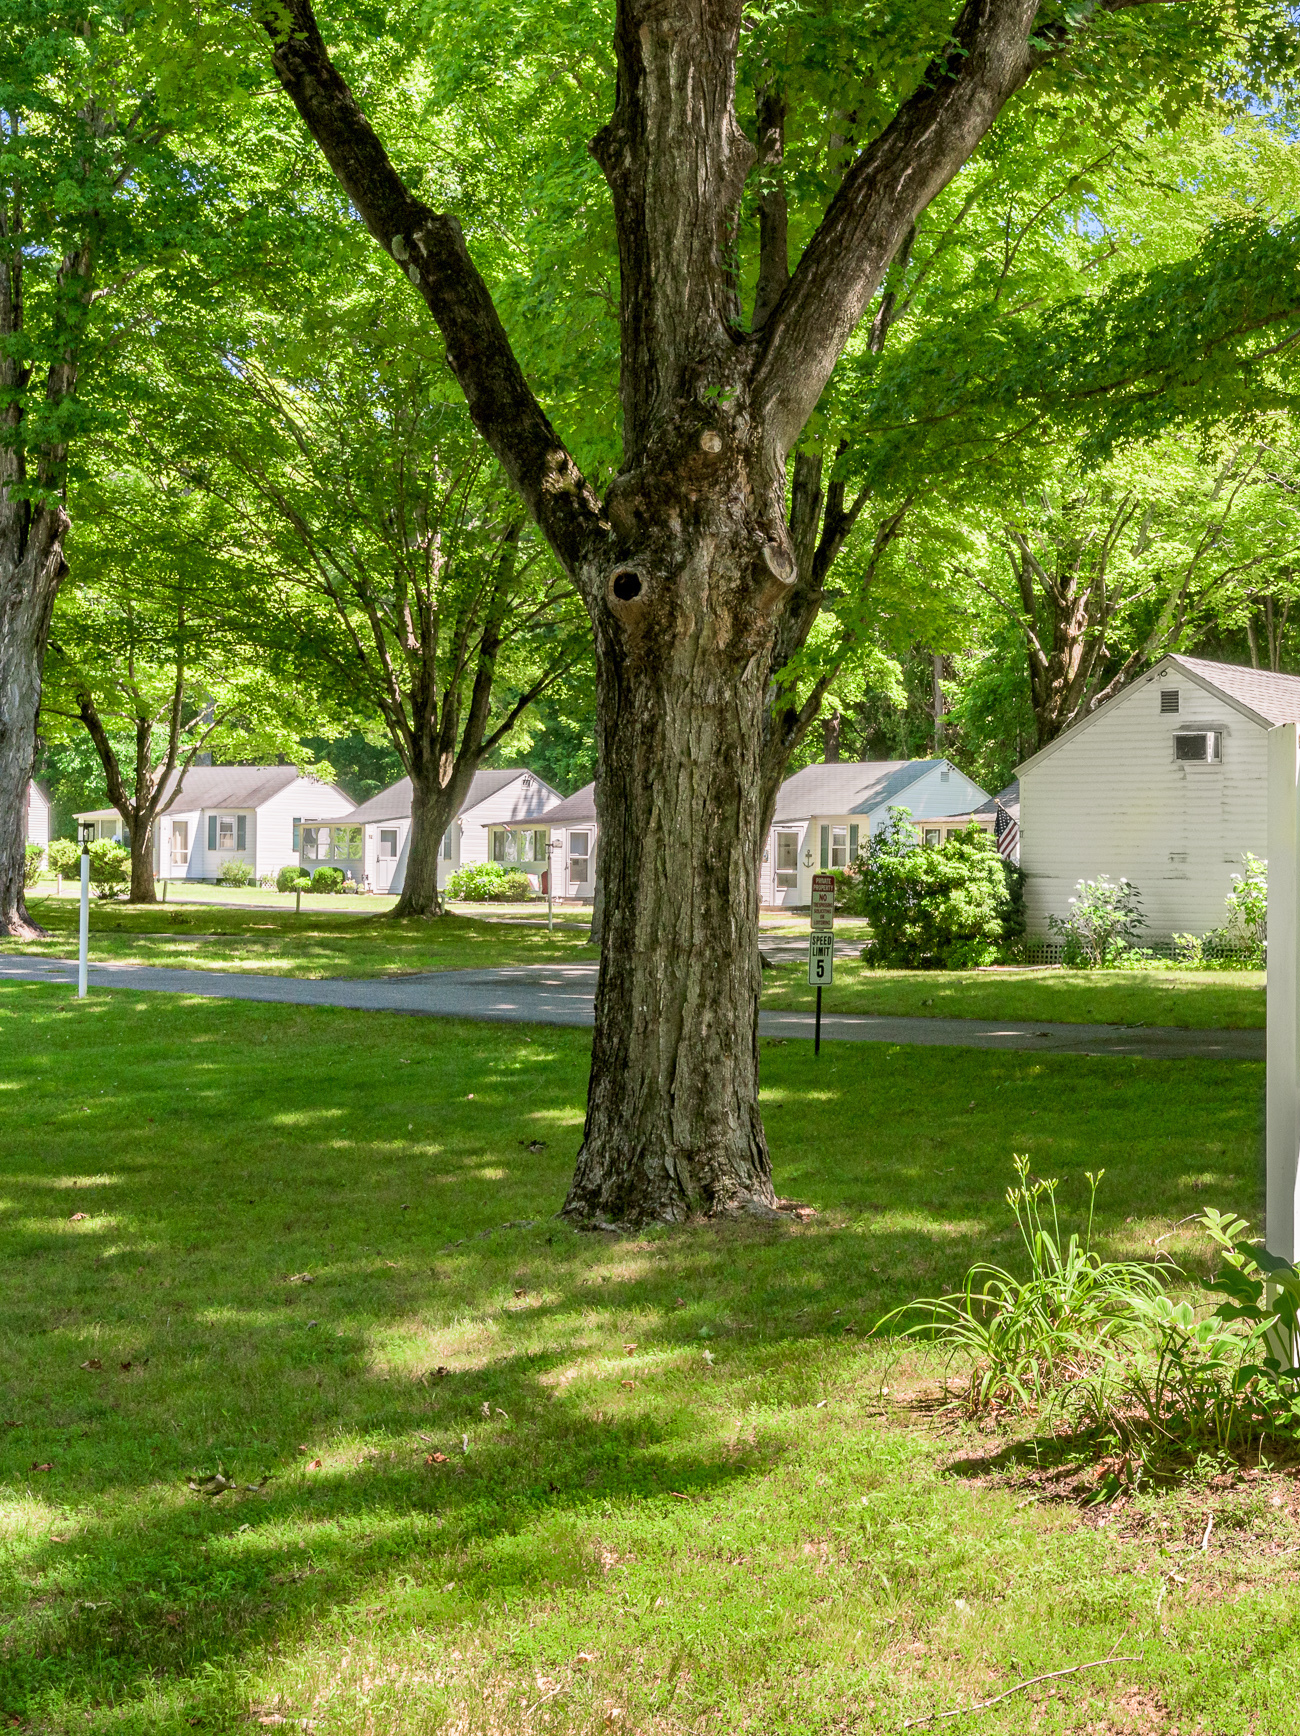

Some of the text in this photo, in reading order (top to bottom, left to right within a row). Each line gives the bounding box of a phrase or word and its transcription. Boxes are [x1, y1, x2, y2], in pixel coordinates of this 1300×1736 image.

[813, 884, 834, 892] PROPERTY
[819, 894, 827, 902] NO
[812, 935, 832, 945] SPEED
[812, 946, 831, 956] LIMIT
[816, 959, 824, 978] 5
